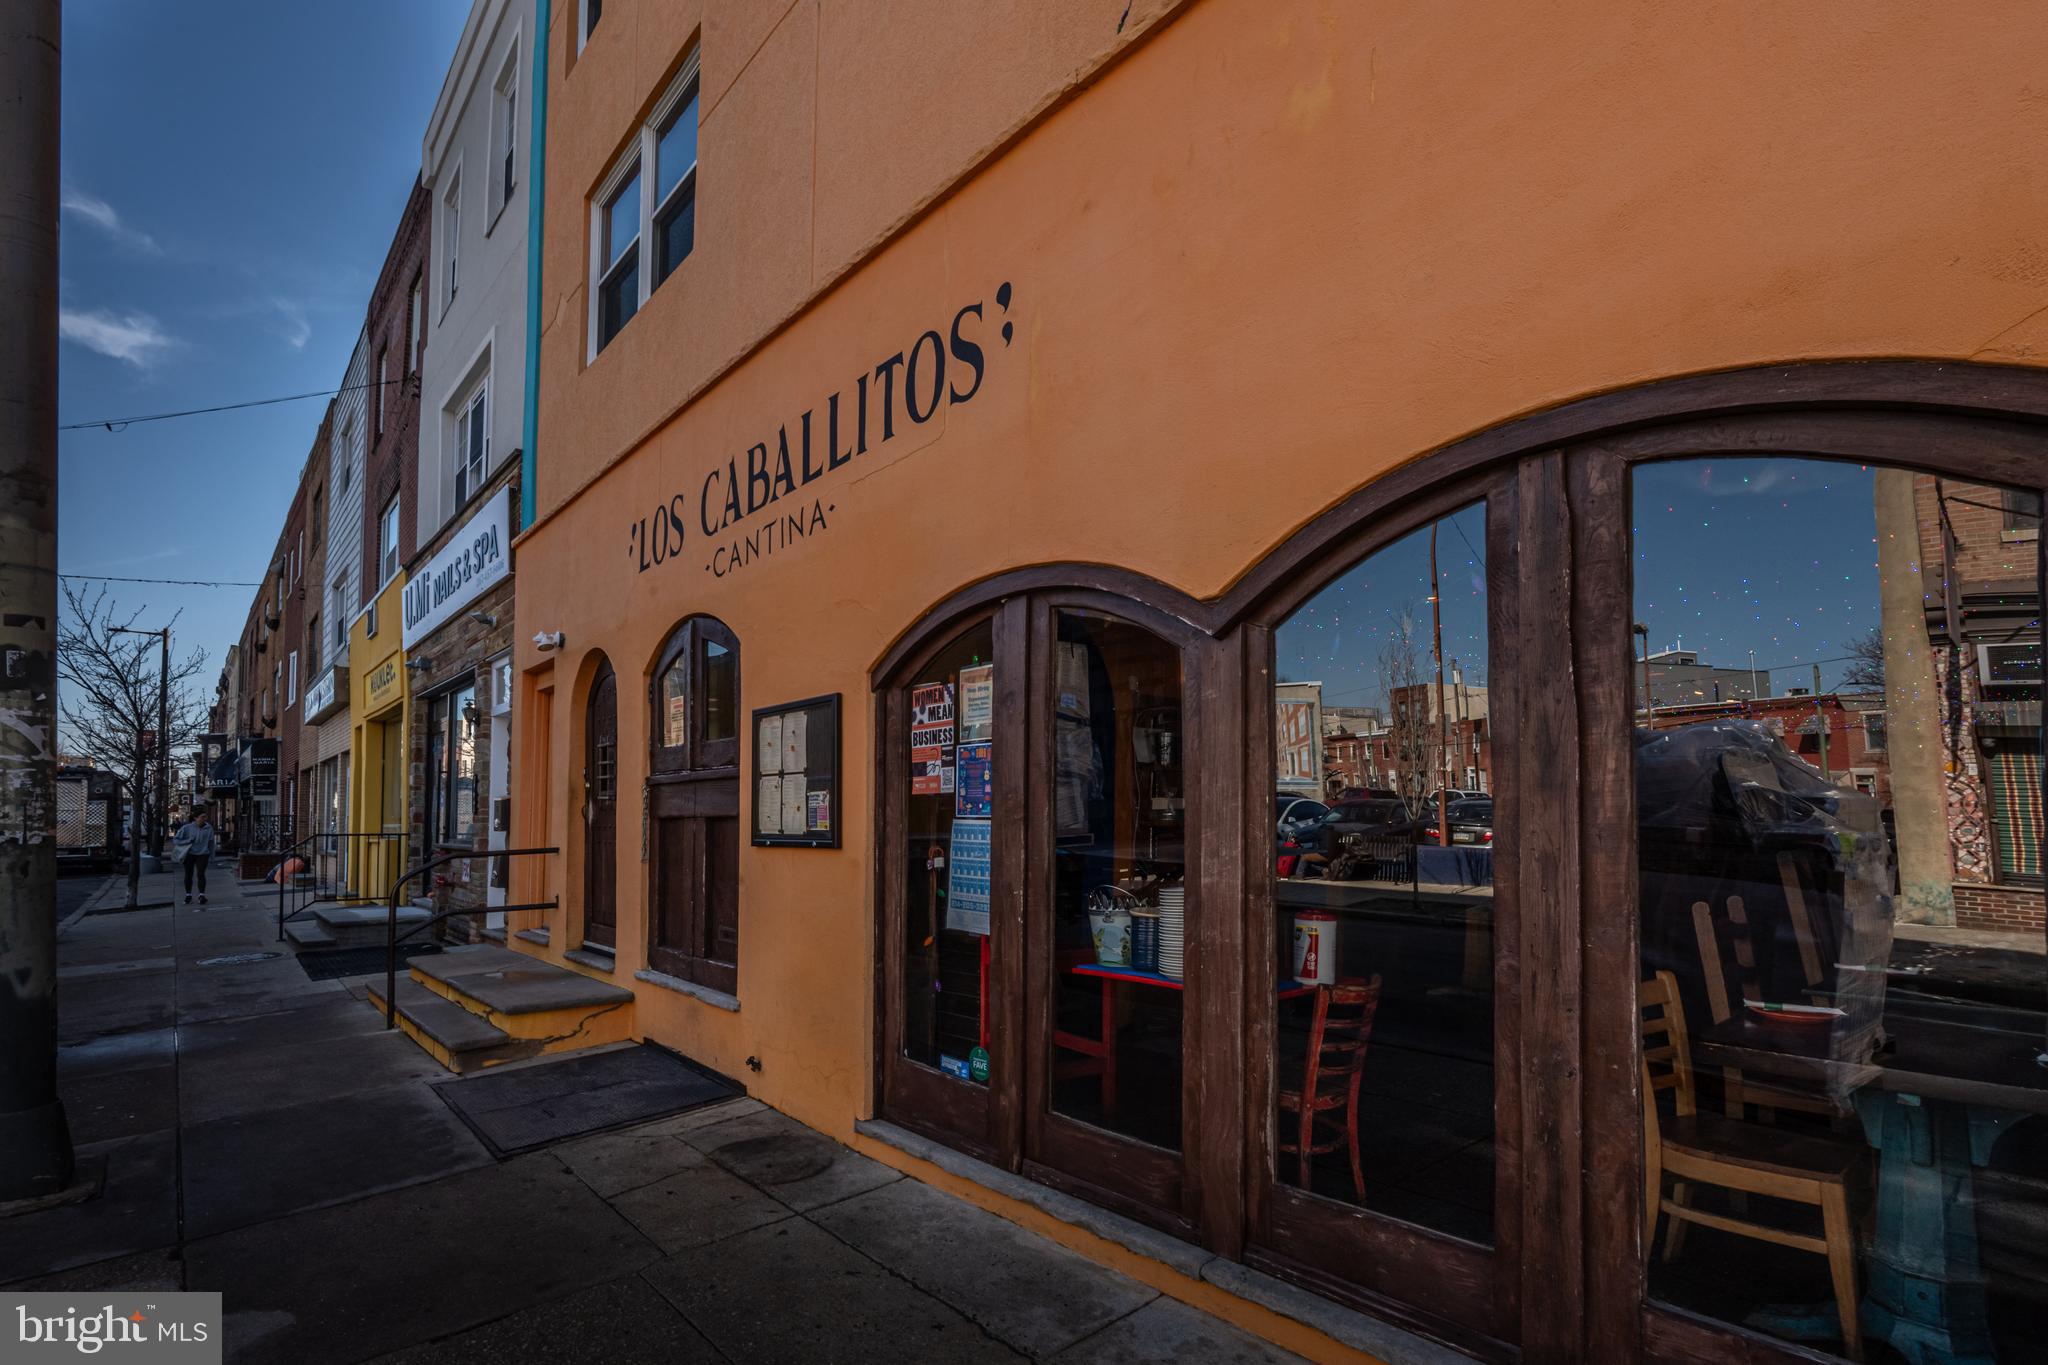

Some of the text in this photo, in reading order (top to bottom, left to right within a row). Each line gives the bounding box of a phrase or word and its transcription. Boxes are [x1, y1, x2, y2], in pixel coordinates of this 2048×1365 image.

[433, 556, 462, 609] NAILS
[463, 548, 472, 583] &
[473, 524, 500, 574] SPA
[913, 686, 945, 707] WOMEN
[927, 703, 953, 722] MEAN
[912, 728, 953, 747] BUSINESS
